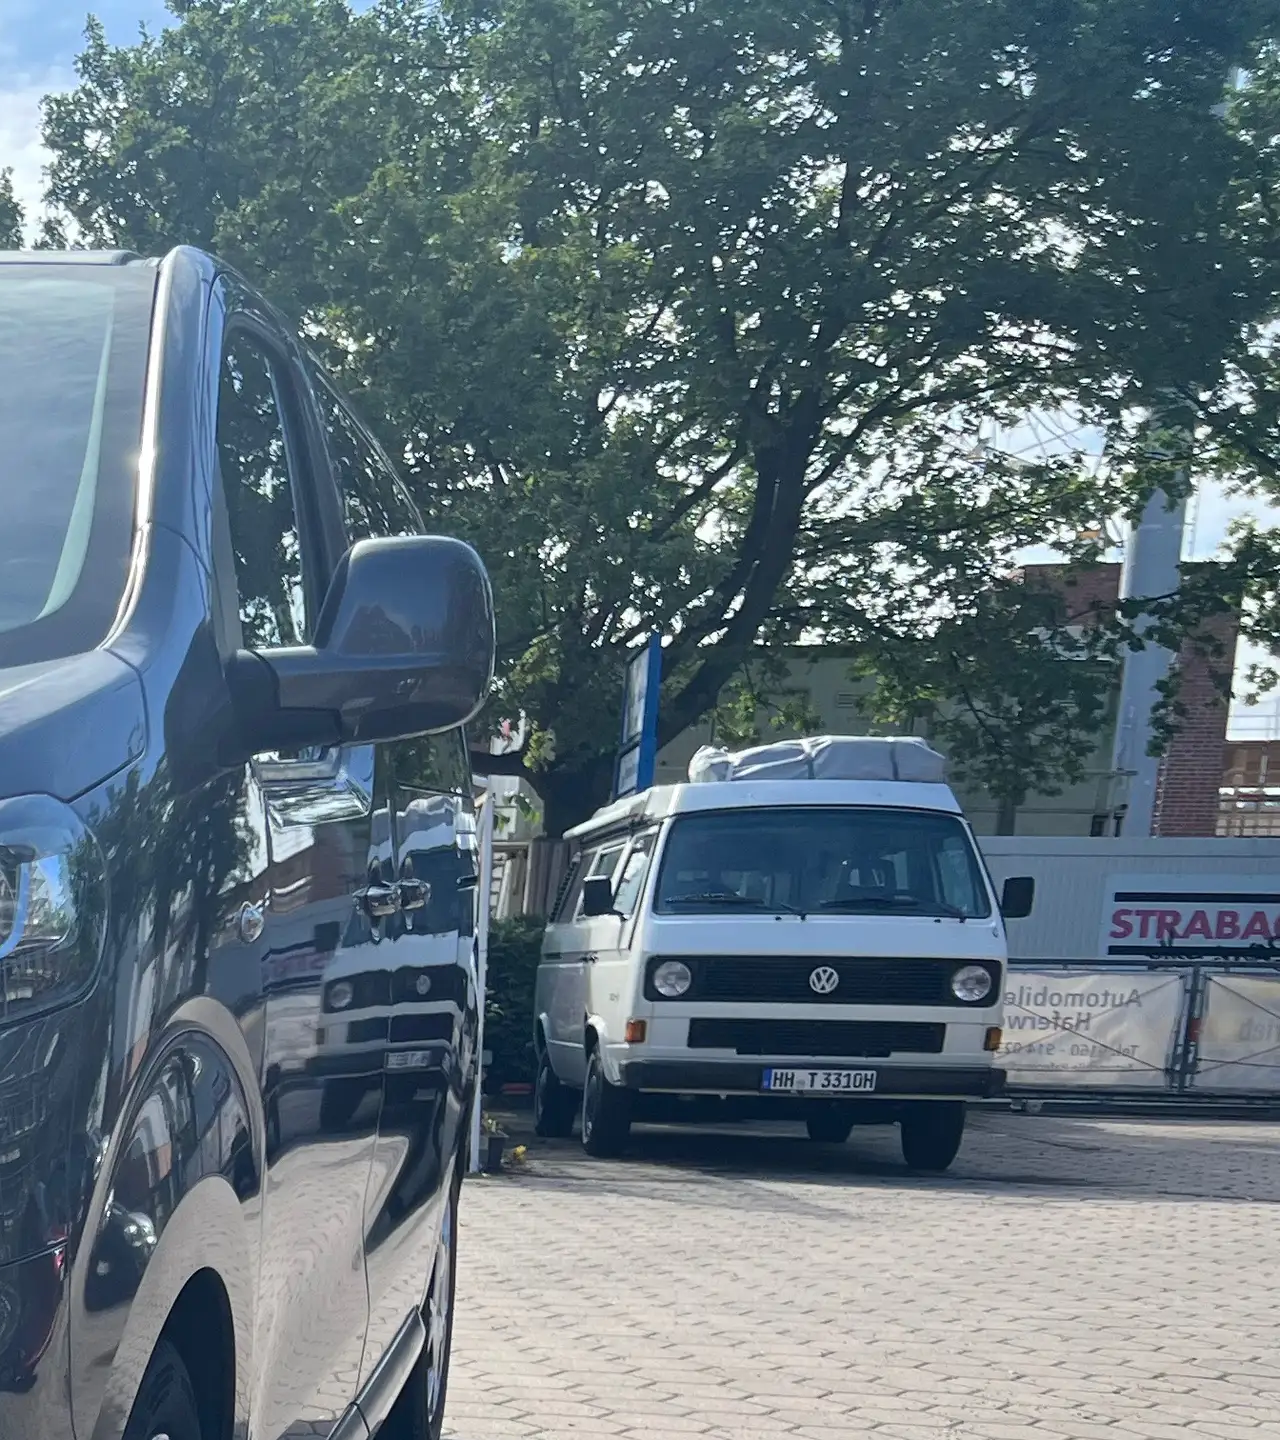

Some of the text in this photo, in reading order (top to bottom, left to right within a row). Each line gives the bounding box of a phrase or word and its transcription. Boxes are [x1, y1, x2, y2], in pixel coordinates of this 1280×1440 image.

[1109, 909, 1280, 940] STRABA
[772, 1071, 874, 1089] HH T 3310H
